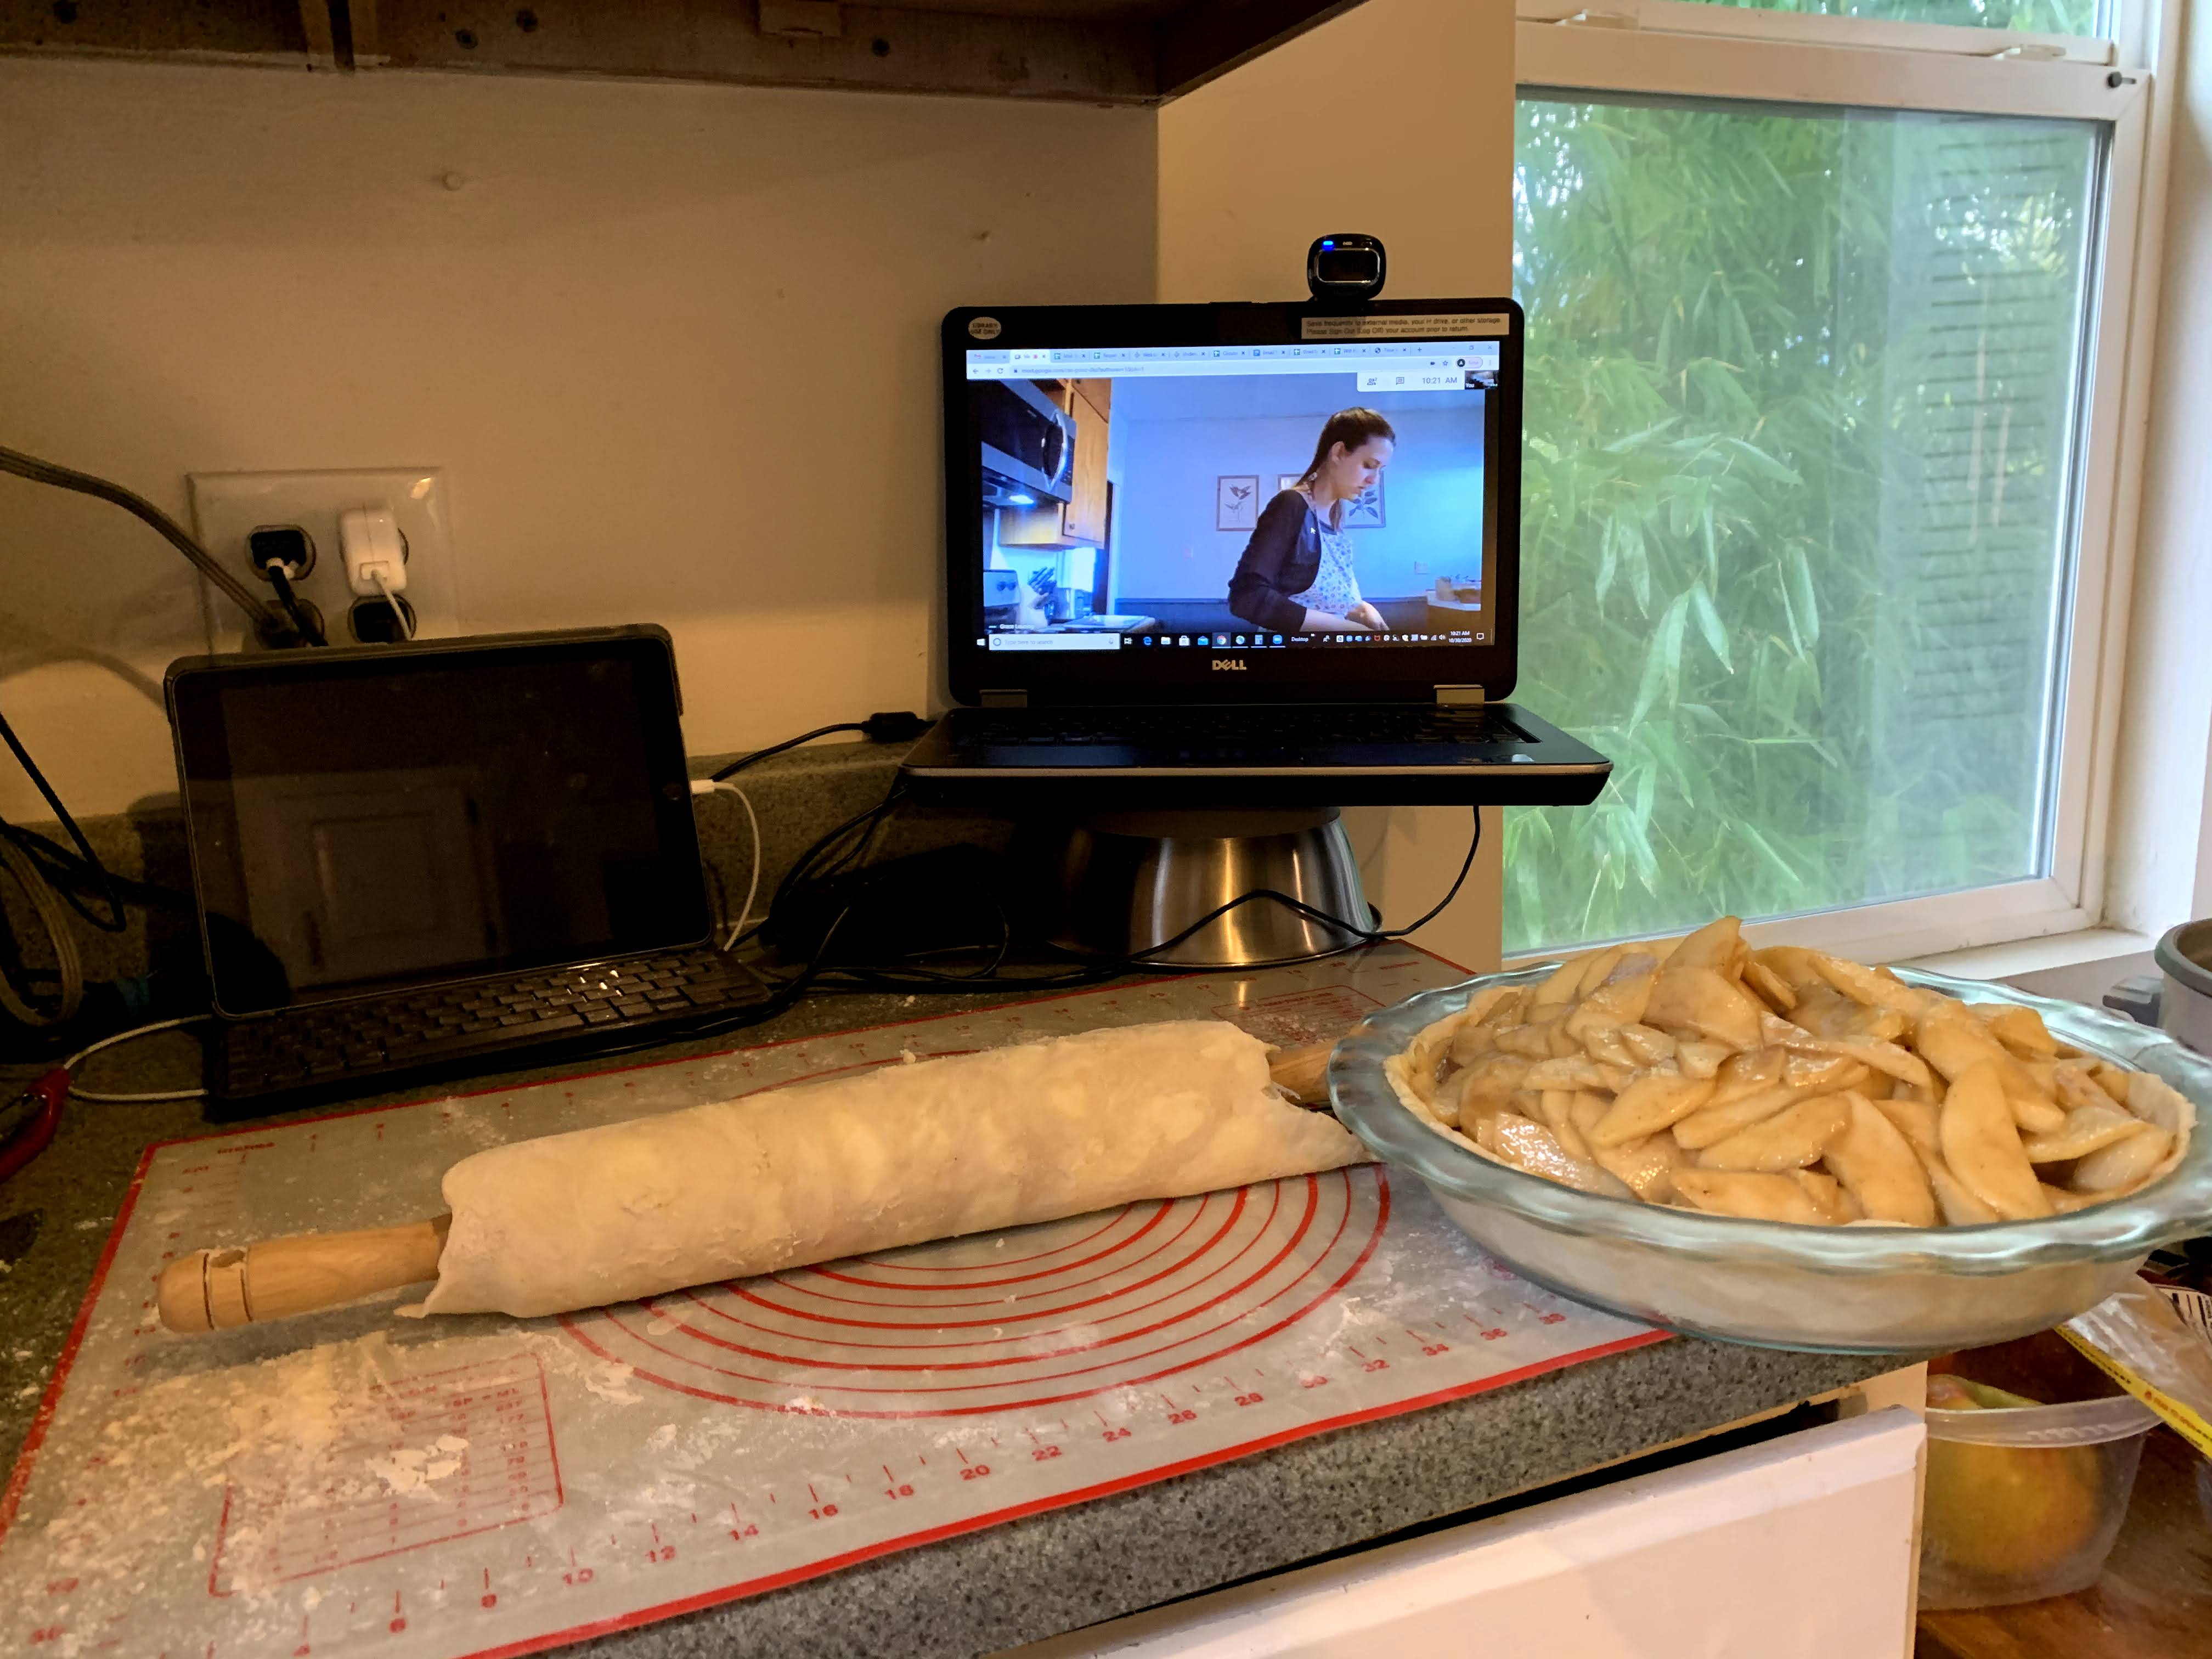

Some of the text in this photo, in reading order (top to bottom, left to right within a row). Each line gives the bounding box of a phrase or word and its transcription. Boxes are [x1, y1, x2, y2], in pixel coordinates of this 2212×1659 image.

[1212, 659, 1247, 670] DELL
[562, 1567, 594, 1585] 10
[646, 1545, 677, 1563] 12
[729, 1522, 759, 1541] 14
[884, 1484, 915, 1500] 18
[960, 1464, 991, 1481] 20
[1032, 1445, 1063, 1462] 22
[1102, 1427, 1132, 1443] 24
[1234, 1392, 1264, 1407] 28
[1361, 1359, 1390, 1372] 32
[1422, 1343, 1449, 1356] 34
